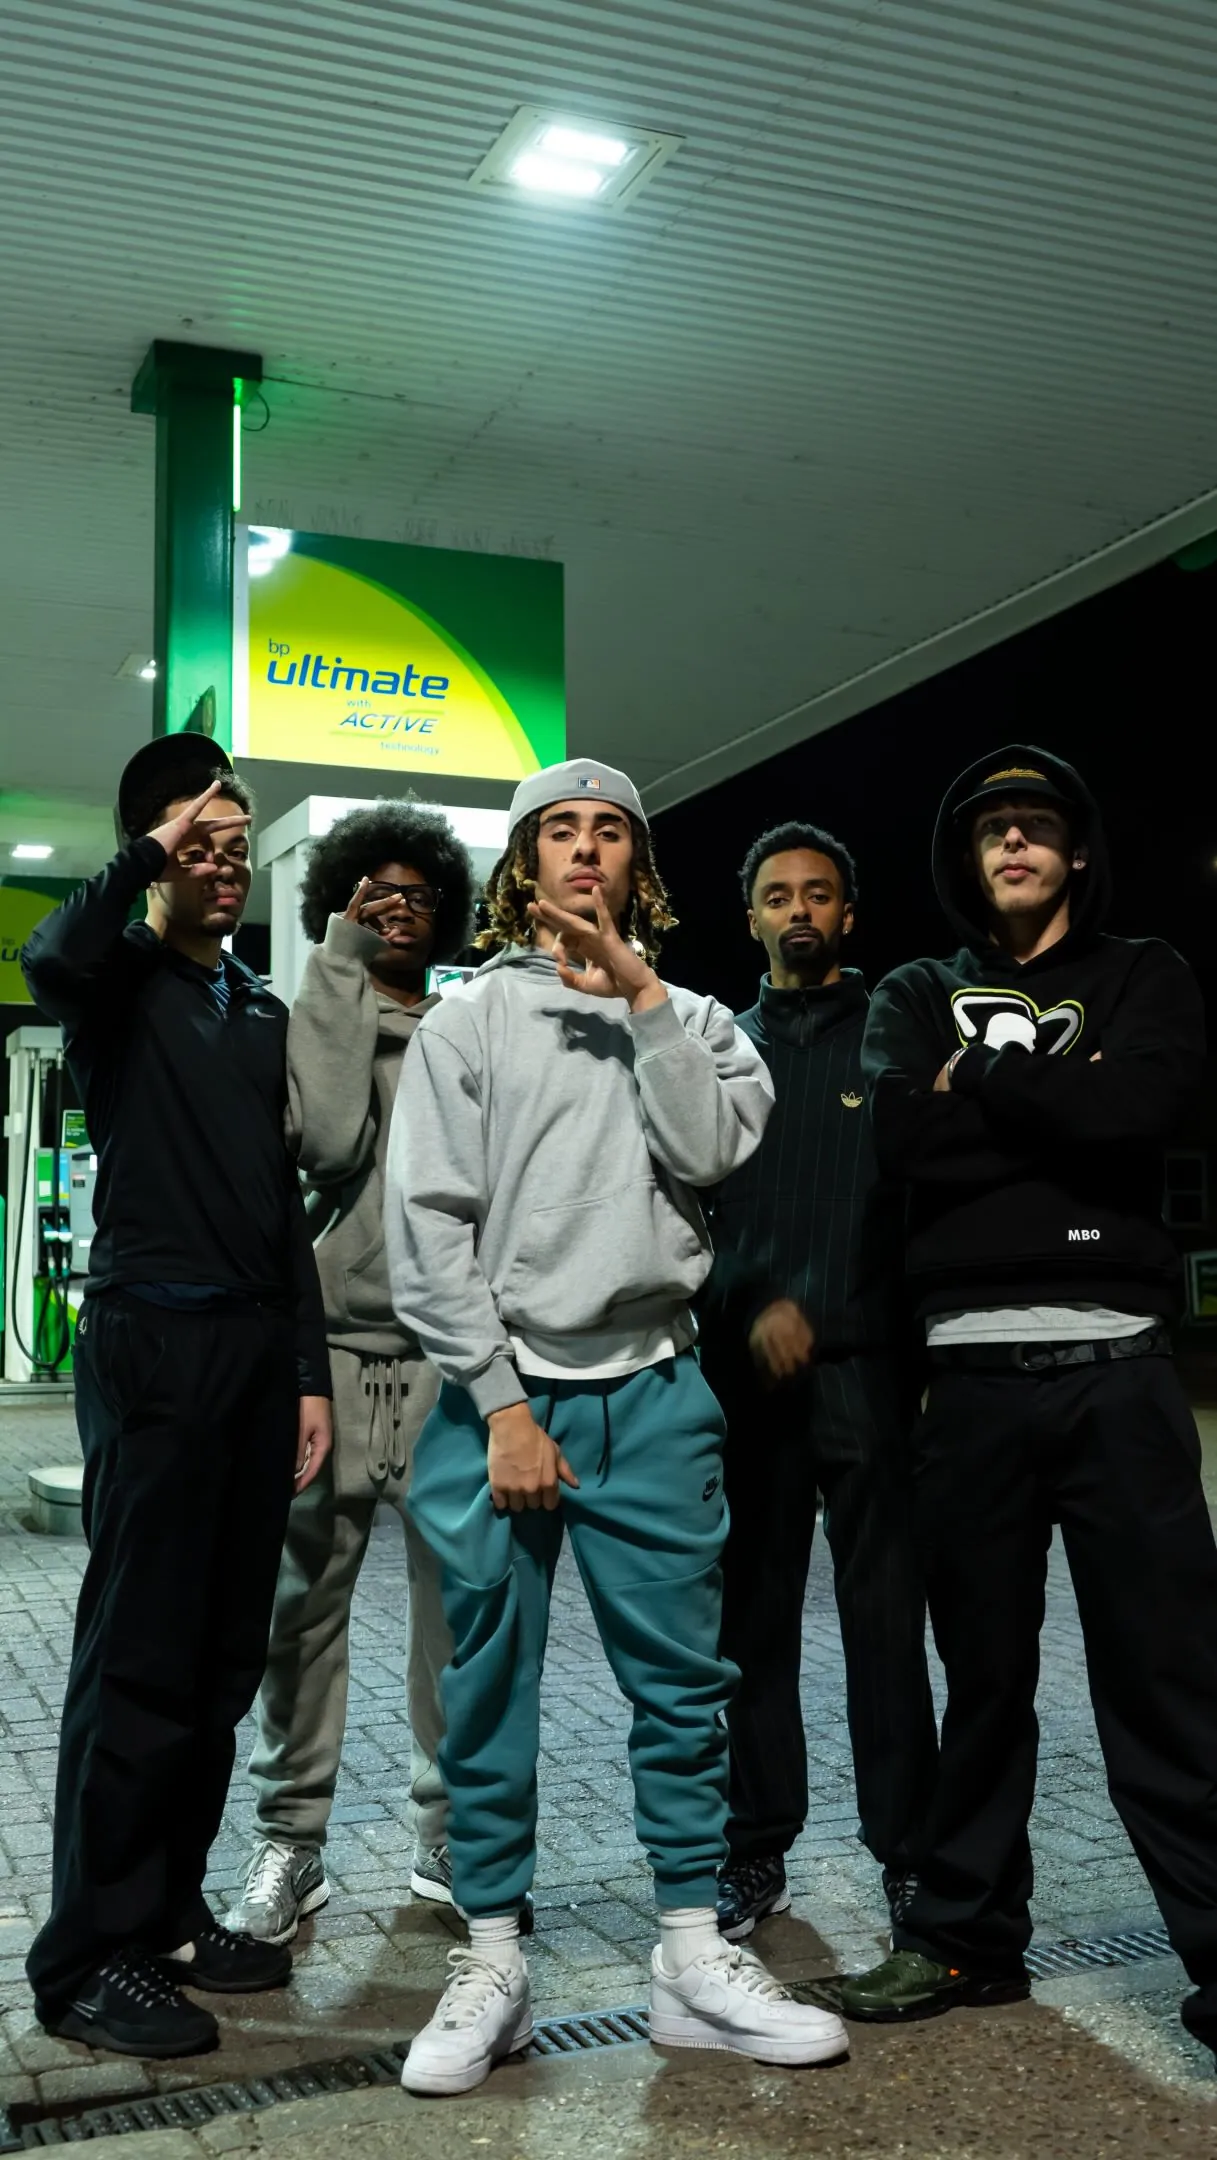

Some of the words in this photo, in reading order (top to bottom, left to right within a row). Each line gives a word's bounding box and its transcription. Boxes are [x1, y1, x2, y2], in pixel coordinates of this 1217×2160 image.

[268, 637, 290, 657] bp
[267, 654, 450, 700] ultimate
[346, 699, 372, 709] with
[340, 711, 438, 733] ACTIVE
[380, 741, 440, 756] technology
[1068, 1229, 1101, 1241] MBO
